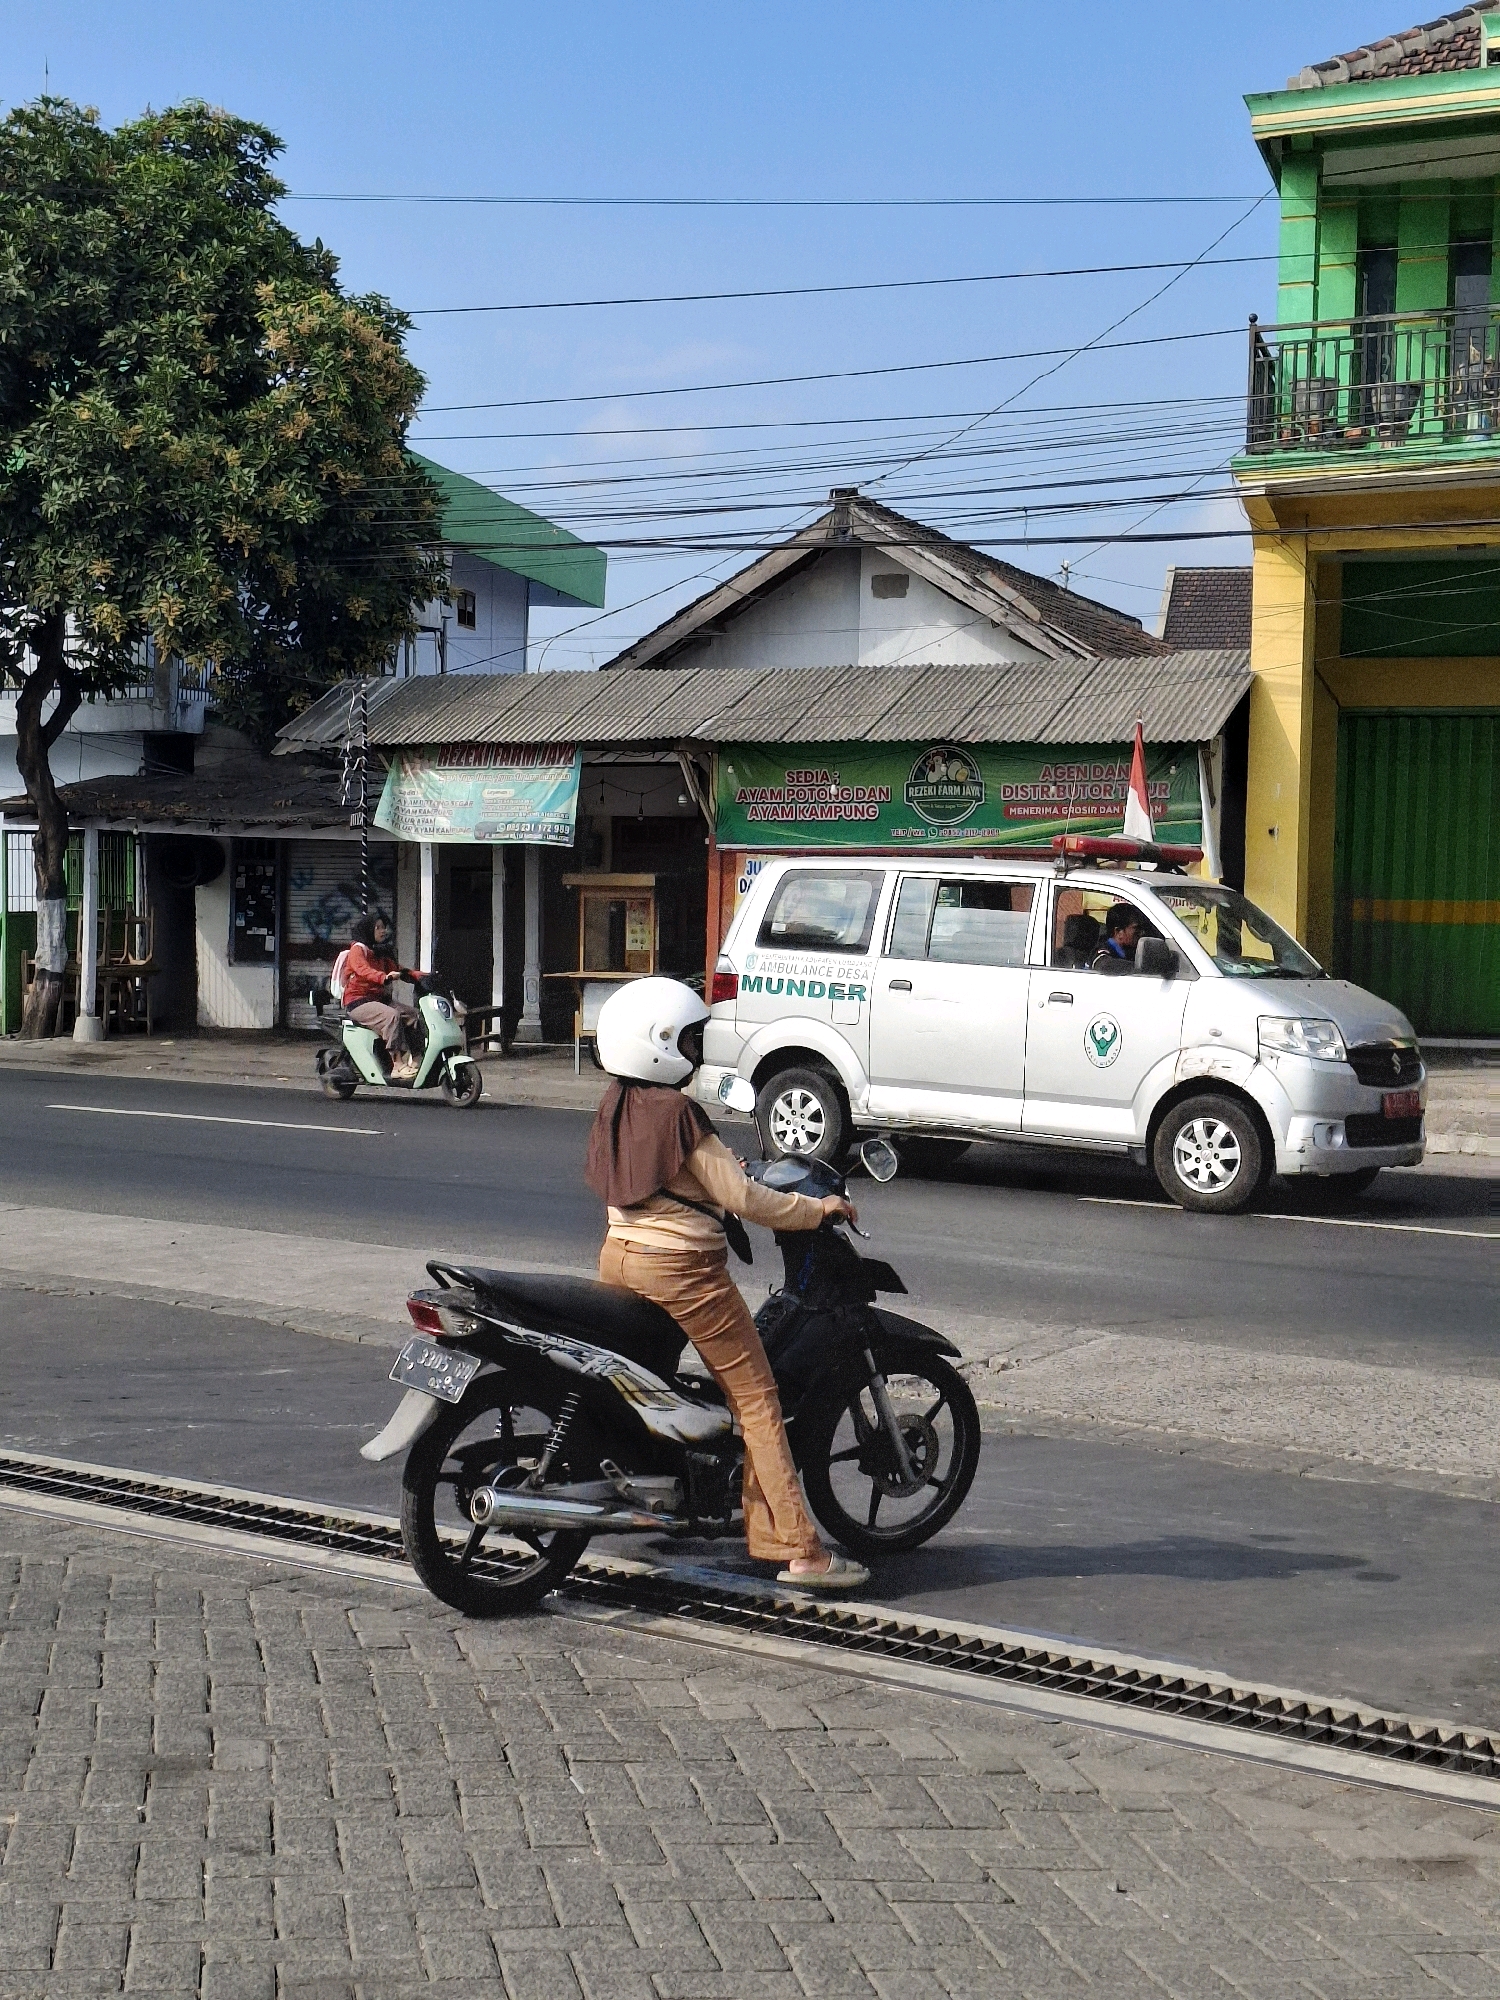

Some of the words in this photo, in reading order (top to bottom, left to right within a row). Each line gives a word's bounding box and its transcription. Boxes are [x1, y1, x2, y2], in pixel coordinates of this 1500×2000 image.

[437, 743, 490, 768] REZEKI
[491, 743, 539, 769] FARM
[536, 743, 576, 767] JAYA
[1040, 764, 1090, 781] AGEN
[1092, 764, 1130, 780] DAN
[736, 787, 781, 802] AYAM
[786, 787, 852, 802] POTONG
[855, 786, 891, 801] DAN
[909, 785, 936, 797] REZEKI
[938, 785, 960, 796] FARM
[962, 785, 980, 797] JAYA
[394, 806, 417, 816] AYAM
[418, 808, 453, 817] KAMPUNG
[748, 804, 795, 820] AYAM
[798, 803, 879, 820] KAMPUNG
[1009, 806, 1059, 815] MENERIMA
[1062, 805, 1098, 815] GROSIR
[1099, 805, 1120, 814] DAN
[521, 823, 535, 832] 231
[538, 824, 552, 833] 172
[758, 961, 833, 978] AMBULANCE
[836, 967, 870, 981] DESA
[741, 974, 867, 1002] MUNDER
[402, 1343, 414, 1361] L
[416, 1347, 453, 1373] 3305
